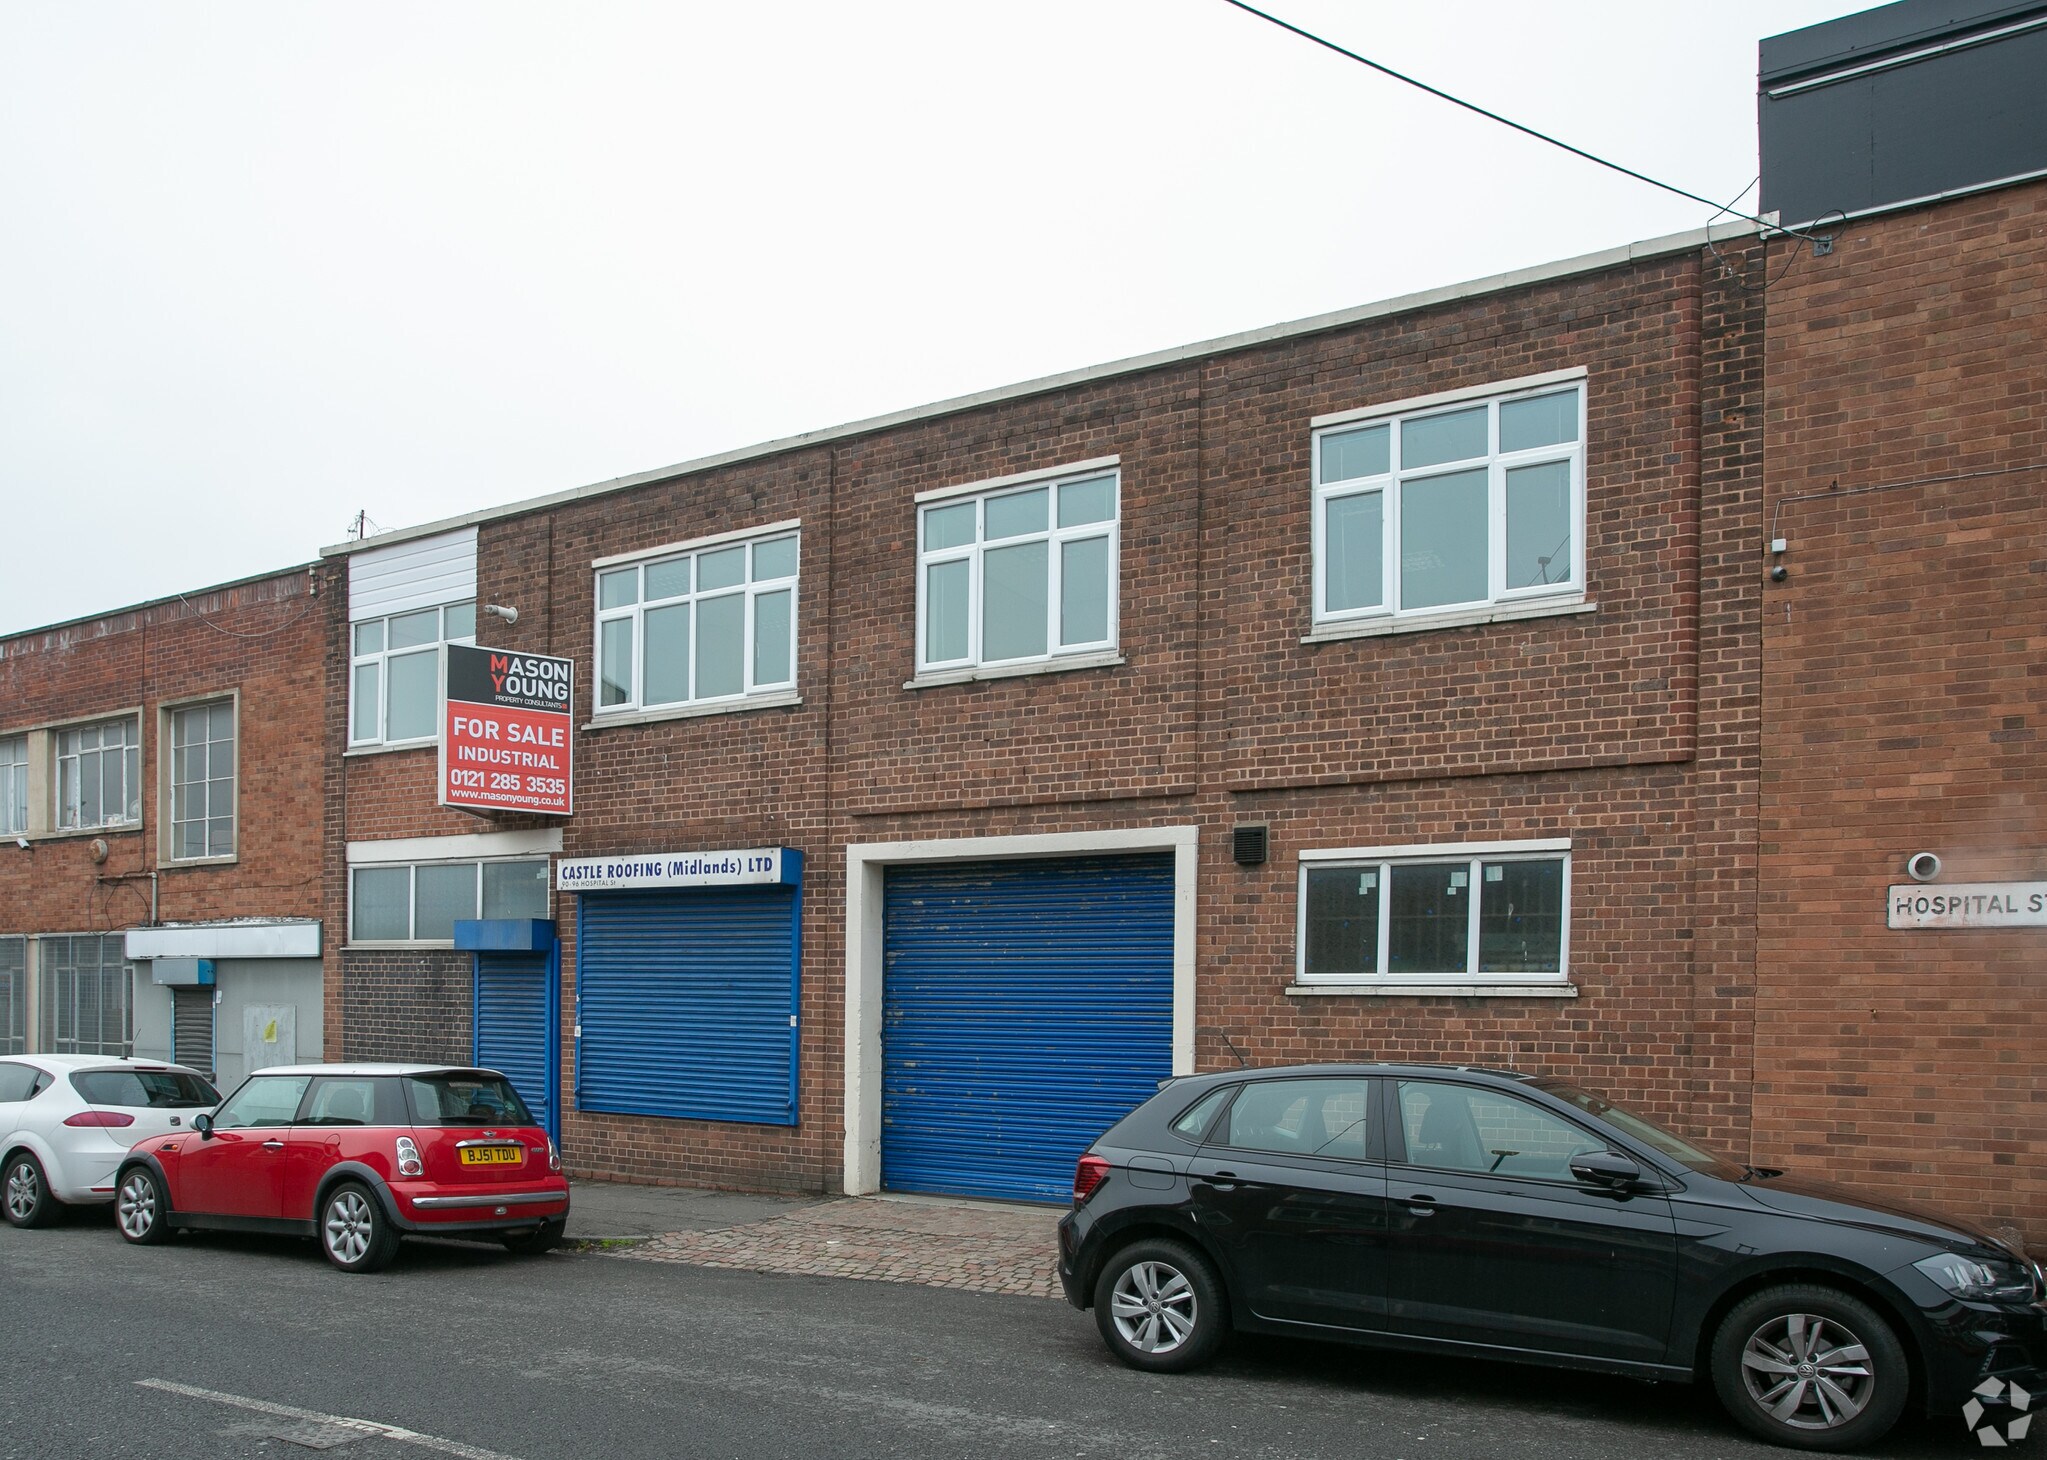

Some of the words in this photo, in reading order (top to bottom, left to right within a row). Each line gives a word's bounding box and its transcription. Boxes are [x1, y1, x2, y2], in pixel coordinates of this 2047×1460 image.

[490, 653, 568, 682] MASON
[491, 673, 568, 700] YOUNG
[495, 695, 524, 704] PROPERTY
[524, 698, 562, 709] CONSULTANTS
[454, 716, 500, 740] FOR
[507, 723, 565, 748] SALE
[458, 745, 560, 770] INDUSTRIAL
[451, 768, 485, 788] 0121
[490, 772, 521, 791] 285
[526, 776, 566, 795] 3535
[451, 788, 565, 806] www.masonyoung.co.uk
[562, 866, 602, 880] CASTLE
[608, 862, 662, 878] ROOFING
[668, 857, 742, 879] (Midlands)
[748, 857, 773, 873] LTD
[1896, 895, 2018, 915] HOSPITAL
[2027, 893, 2047, 913] S
[468, 1149, 493, 1162] BJ51
[494, 1148, 516, 1161] TDU
